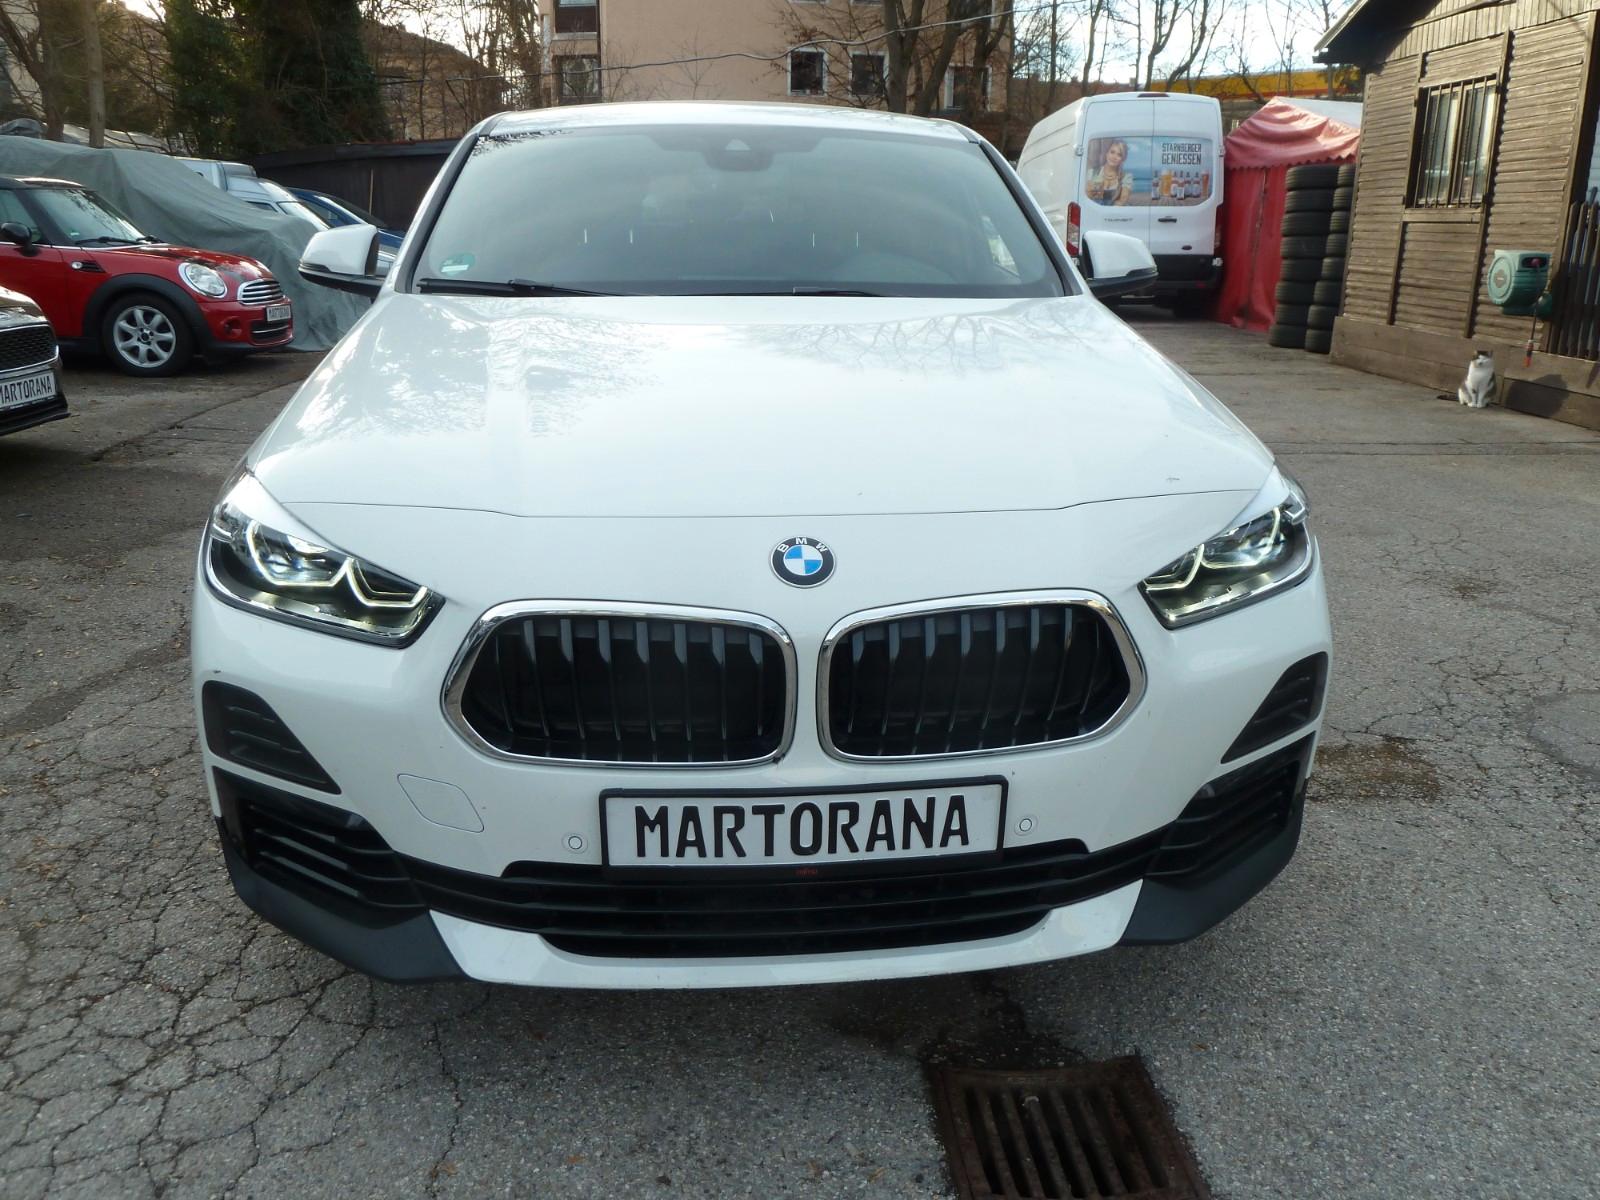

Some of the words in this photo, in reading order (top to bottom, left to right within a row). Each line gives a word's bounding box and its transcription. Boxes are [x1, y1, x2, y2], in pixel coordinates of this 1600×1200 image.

[1161, 143, 1201, 152] STARNBERGER
[1161, 153, 1201, 165] GENIESSEN
[777, 537, 828, 553] BMW
[635, 795, 970, 858] MARTORANA
